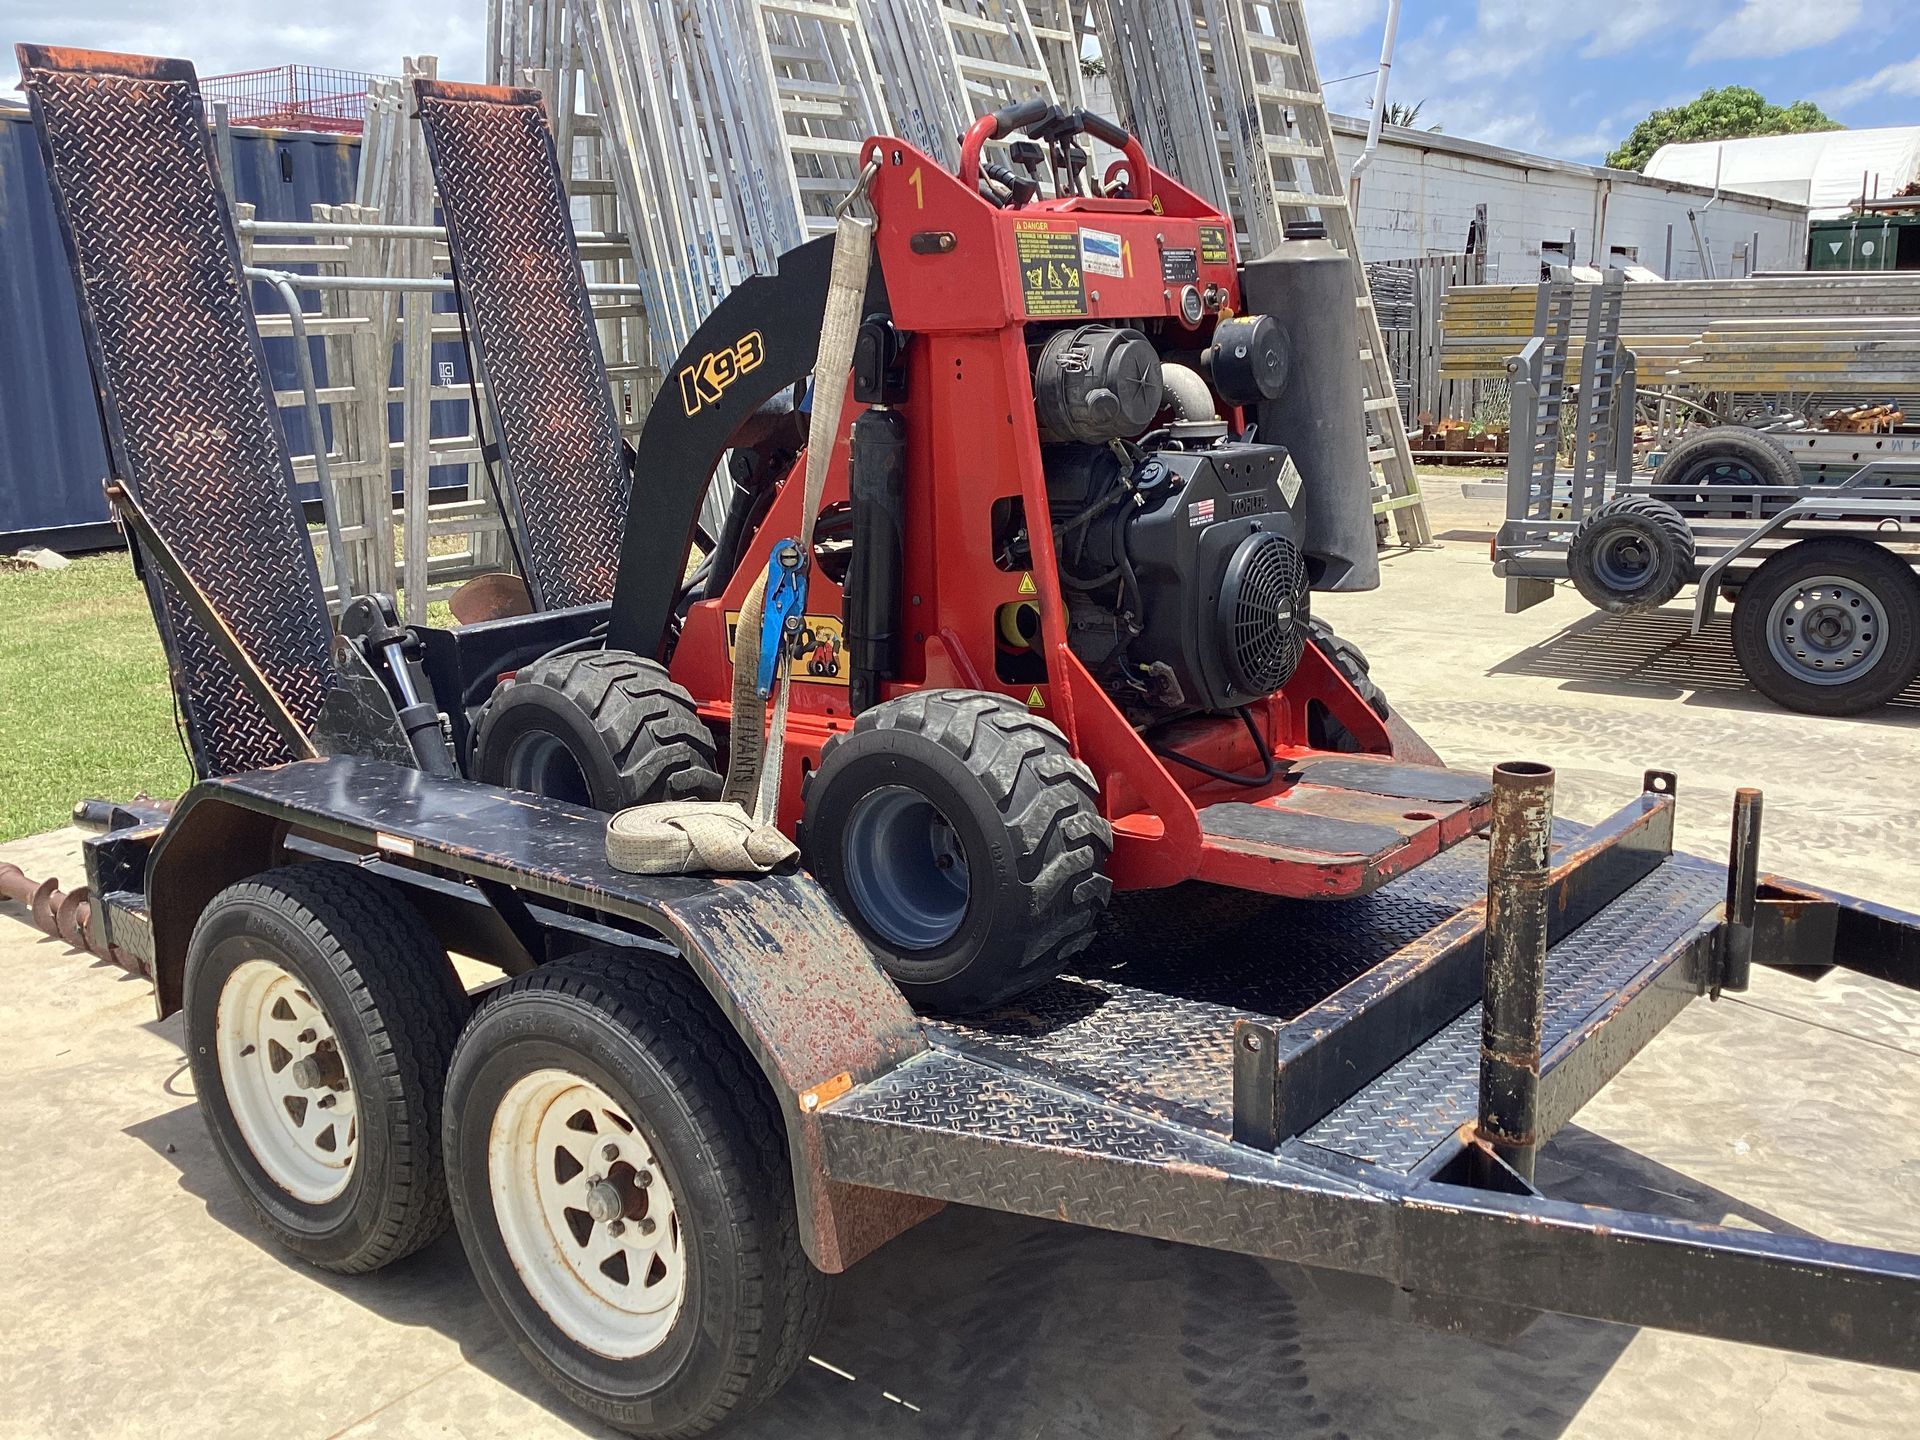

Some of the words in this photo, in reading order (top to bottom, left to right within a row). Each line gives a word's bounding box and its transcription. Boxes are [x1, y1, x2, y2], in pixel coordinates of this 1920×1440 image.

[907, 167, 923, 210] 1
[1023, 221, 1049, 231] DANGER
[1122, 240, 1134, 278] 1
